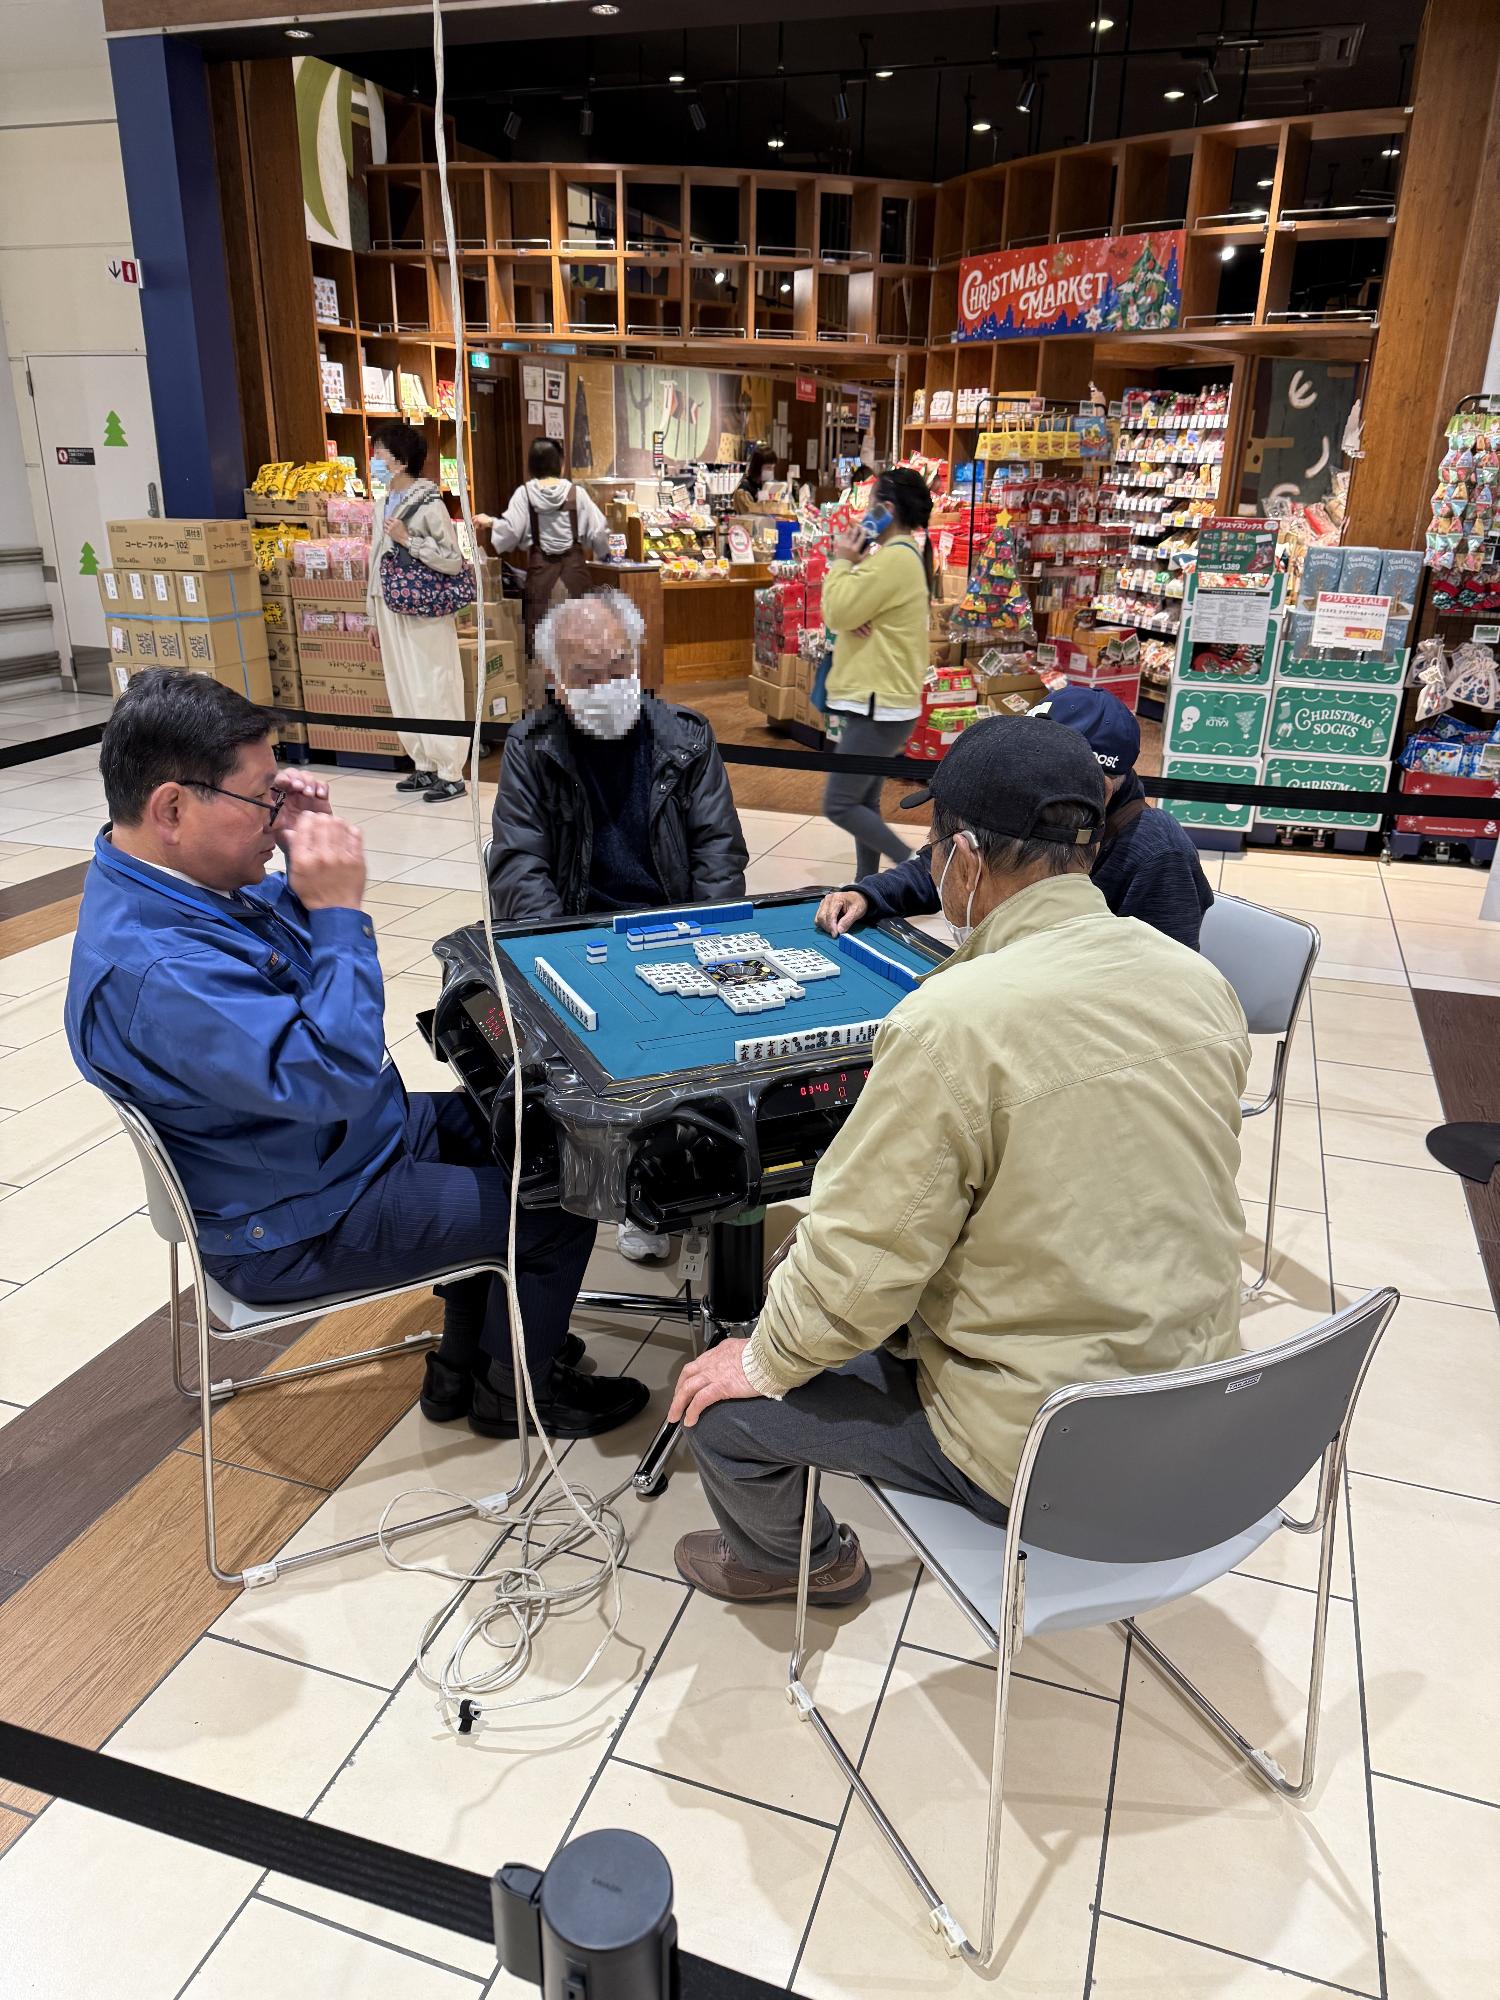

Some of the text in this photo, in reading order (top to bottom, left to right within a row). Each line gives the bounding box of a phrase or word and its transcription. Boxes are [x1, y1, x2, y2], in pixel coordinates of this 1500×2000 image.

[962, 258, 1048, 320] CHRISTMAS
[1019, 271, 1108, 320] MARKET
[1215, 521, 1263, 530] クリスマスソックス
[125, 541, 189, 550] コーヒーフィルター 102
[1365, 629, 1382, 640] 728
[1205, 720, 1229, 728] KALDI
[1294, 707, 1375, 731] CHRISTMAS
[1312, 723, 1359, 739] SOCKS
[800, 1082, 830, 1096] 0340
